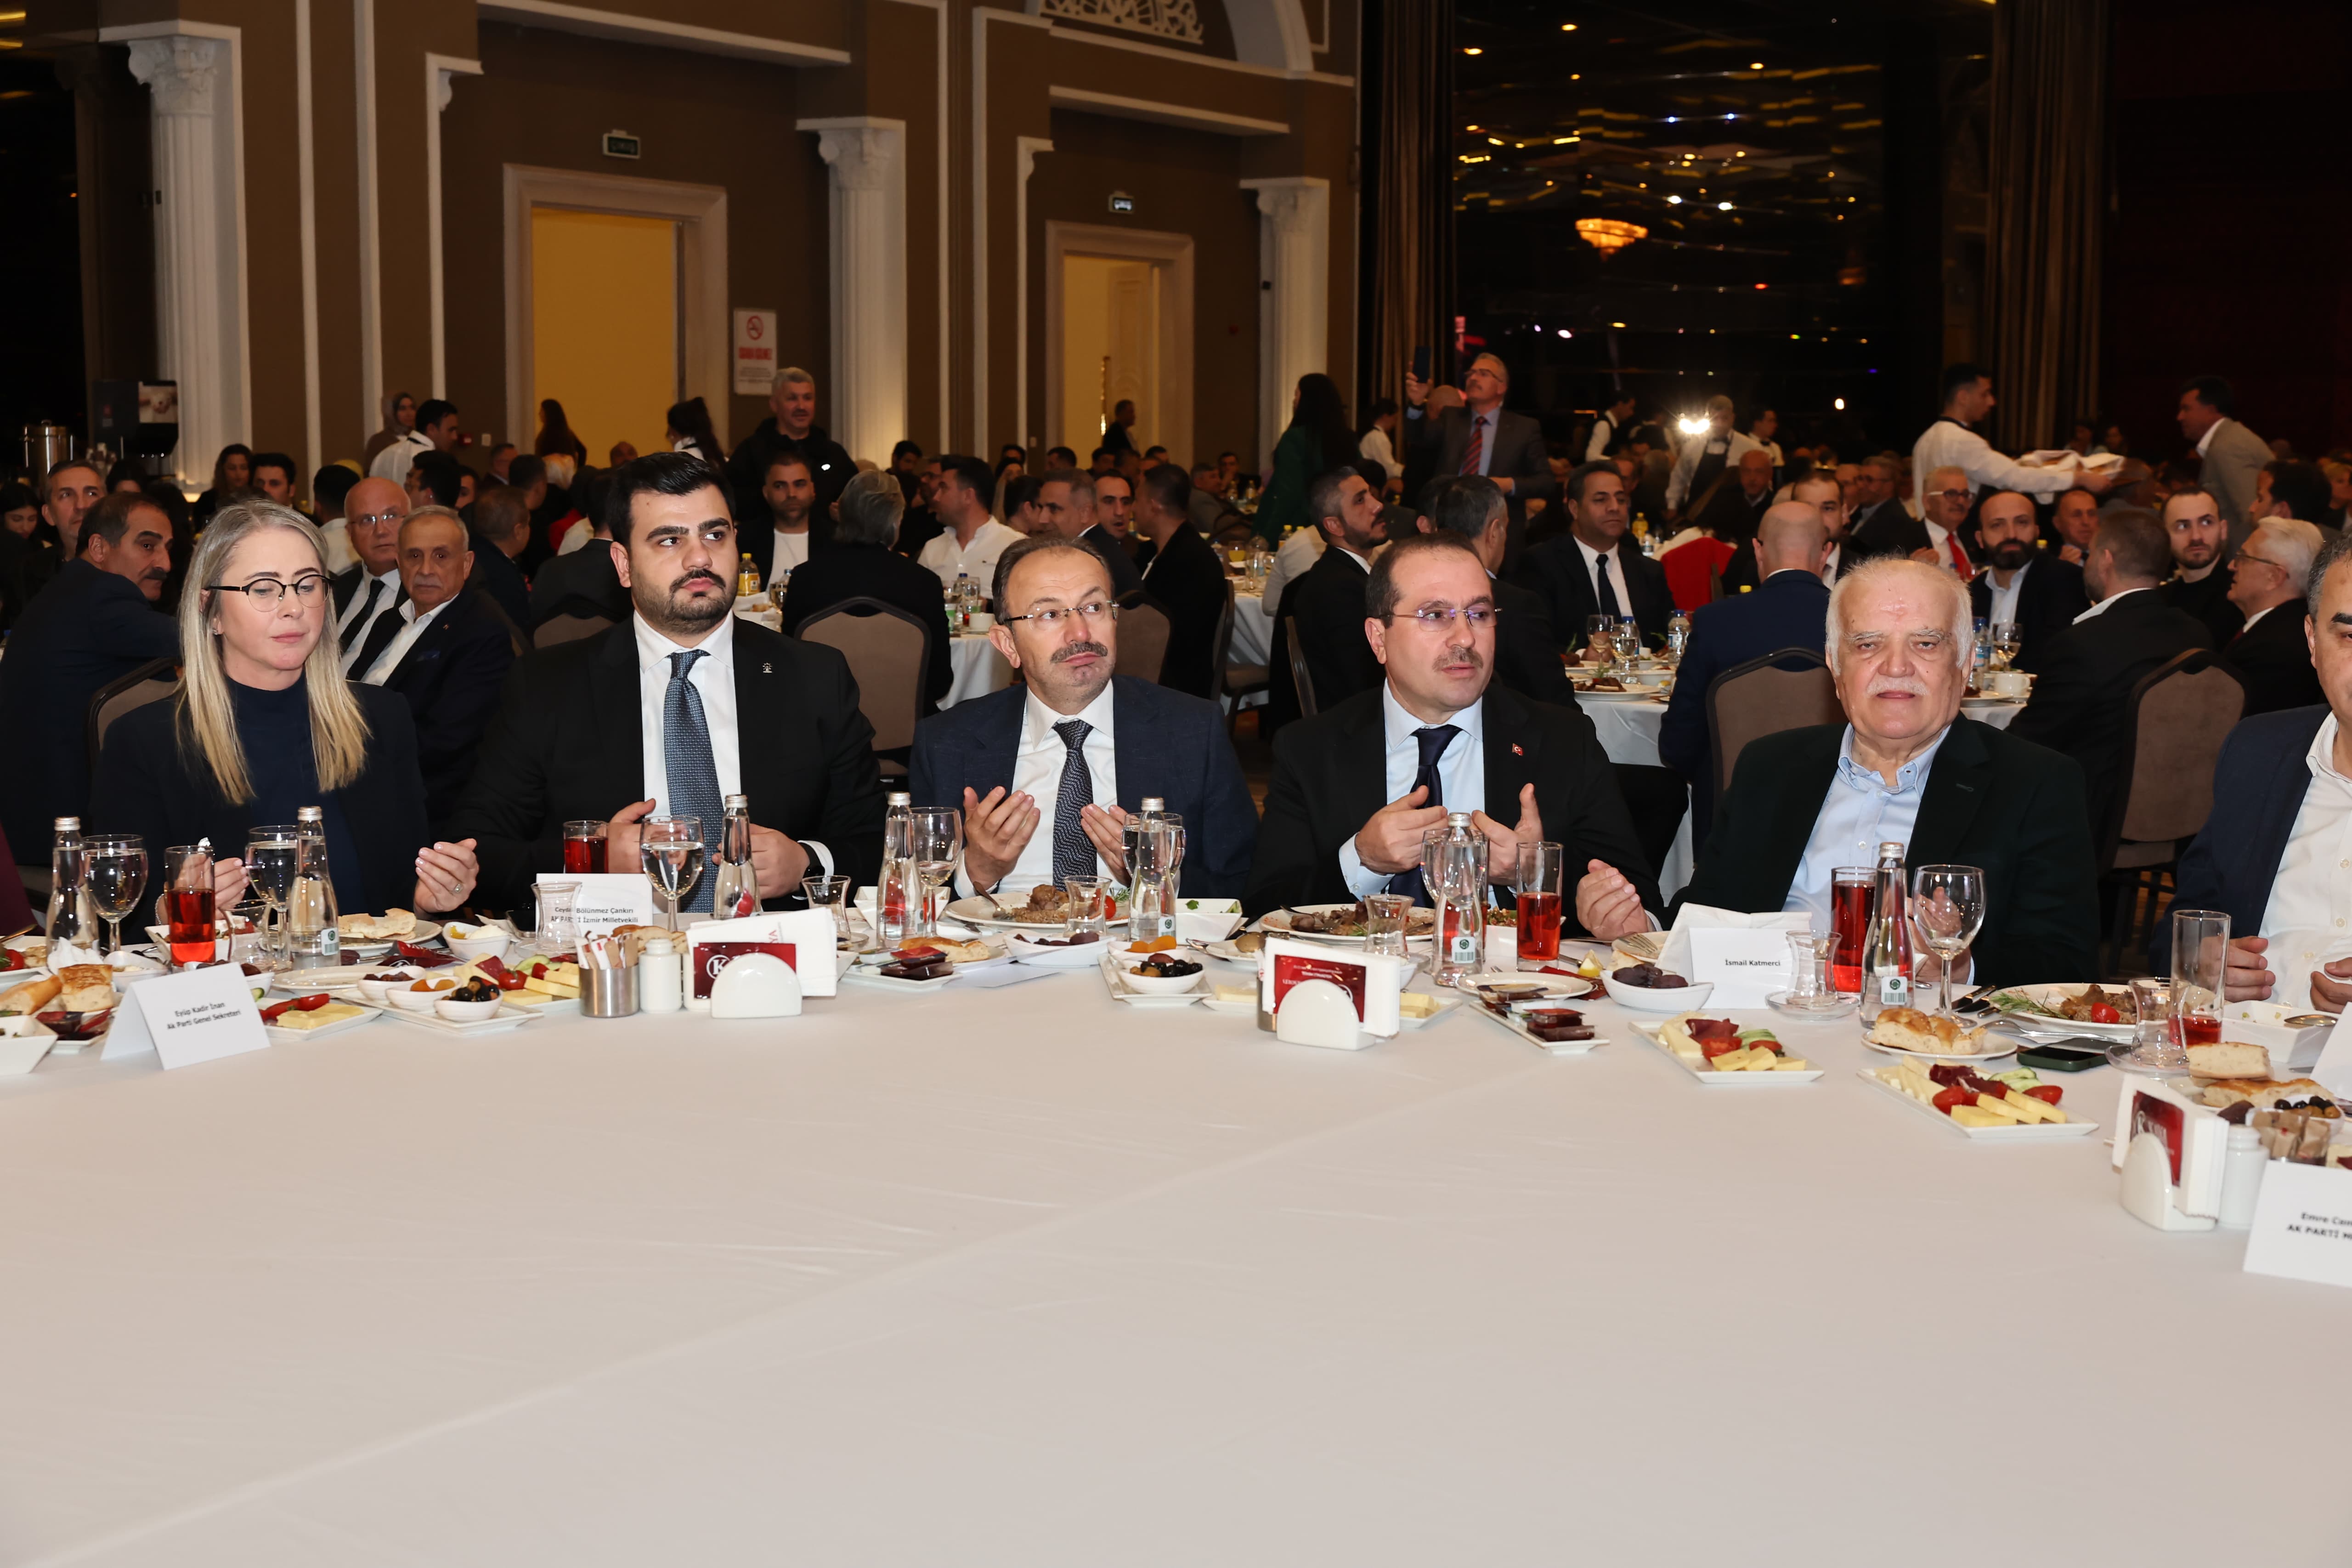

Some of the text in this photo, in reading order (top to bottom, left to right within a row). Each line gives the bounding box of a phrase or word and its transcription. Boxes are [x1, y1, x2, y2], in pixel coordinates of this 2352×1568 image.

[192, 1005, 209, 1013] Kadir
[193, 1015, 212, 1025] Genel
[212, 1008, 242, 1021] Sekreteri
[2302, 1212, 2328, 1223] Emre
[2287, 1224, 2301, 1233] AK
[2306, 1226, 2339, 1239] PARTİ
